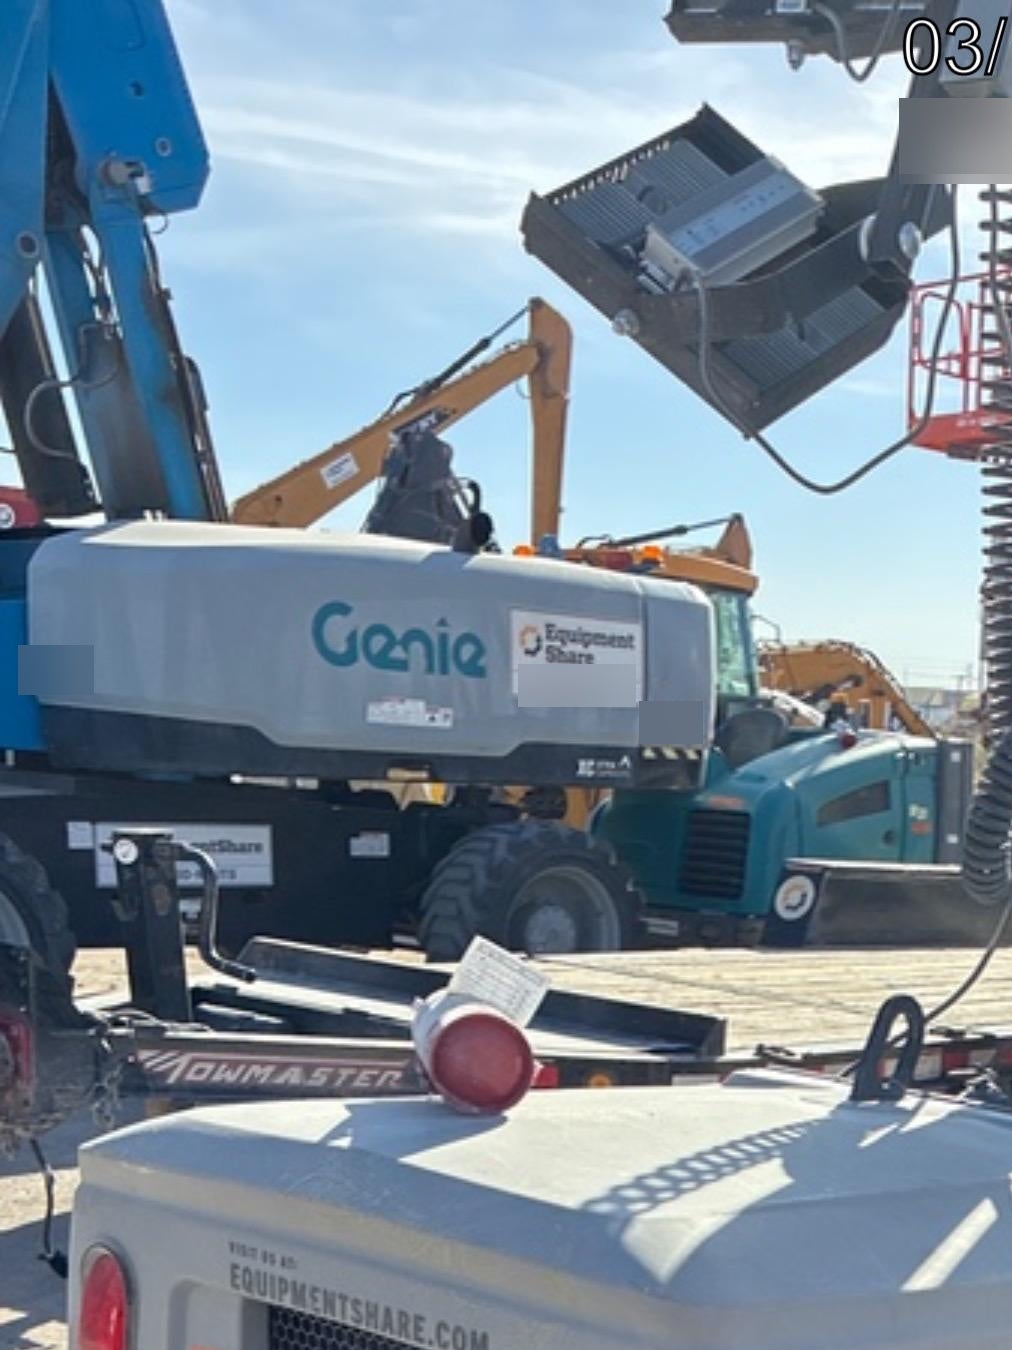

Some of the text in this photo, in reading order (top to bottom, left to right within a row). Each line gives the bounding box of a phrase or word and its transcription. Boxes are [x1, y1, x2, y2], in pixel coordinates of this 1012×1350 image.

[311, 601, 488, 679] Genie
[545, 623, 635, 649] Equipment
[545, 645, 595, 665] Share
